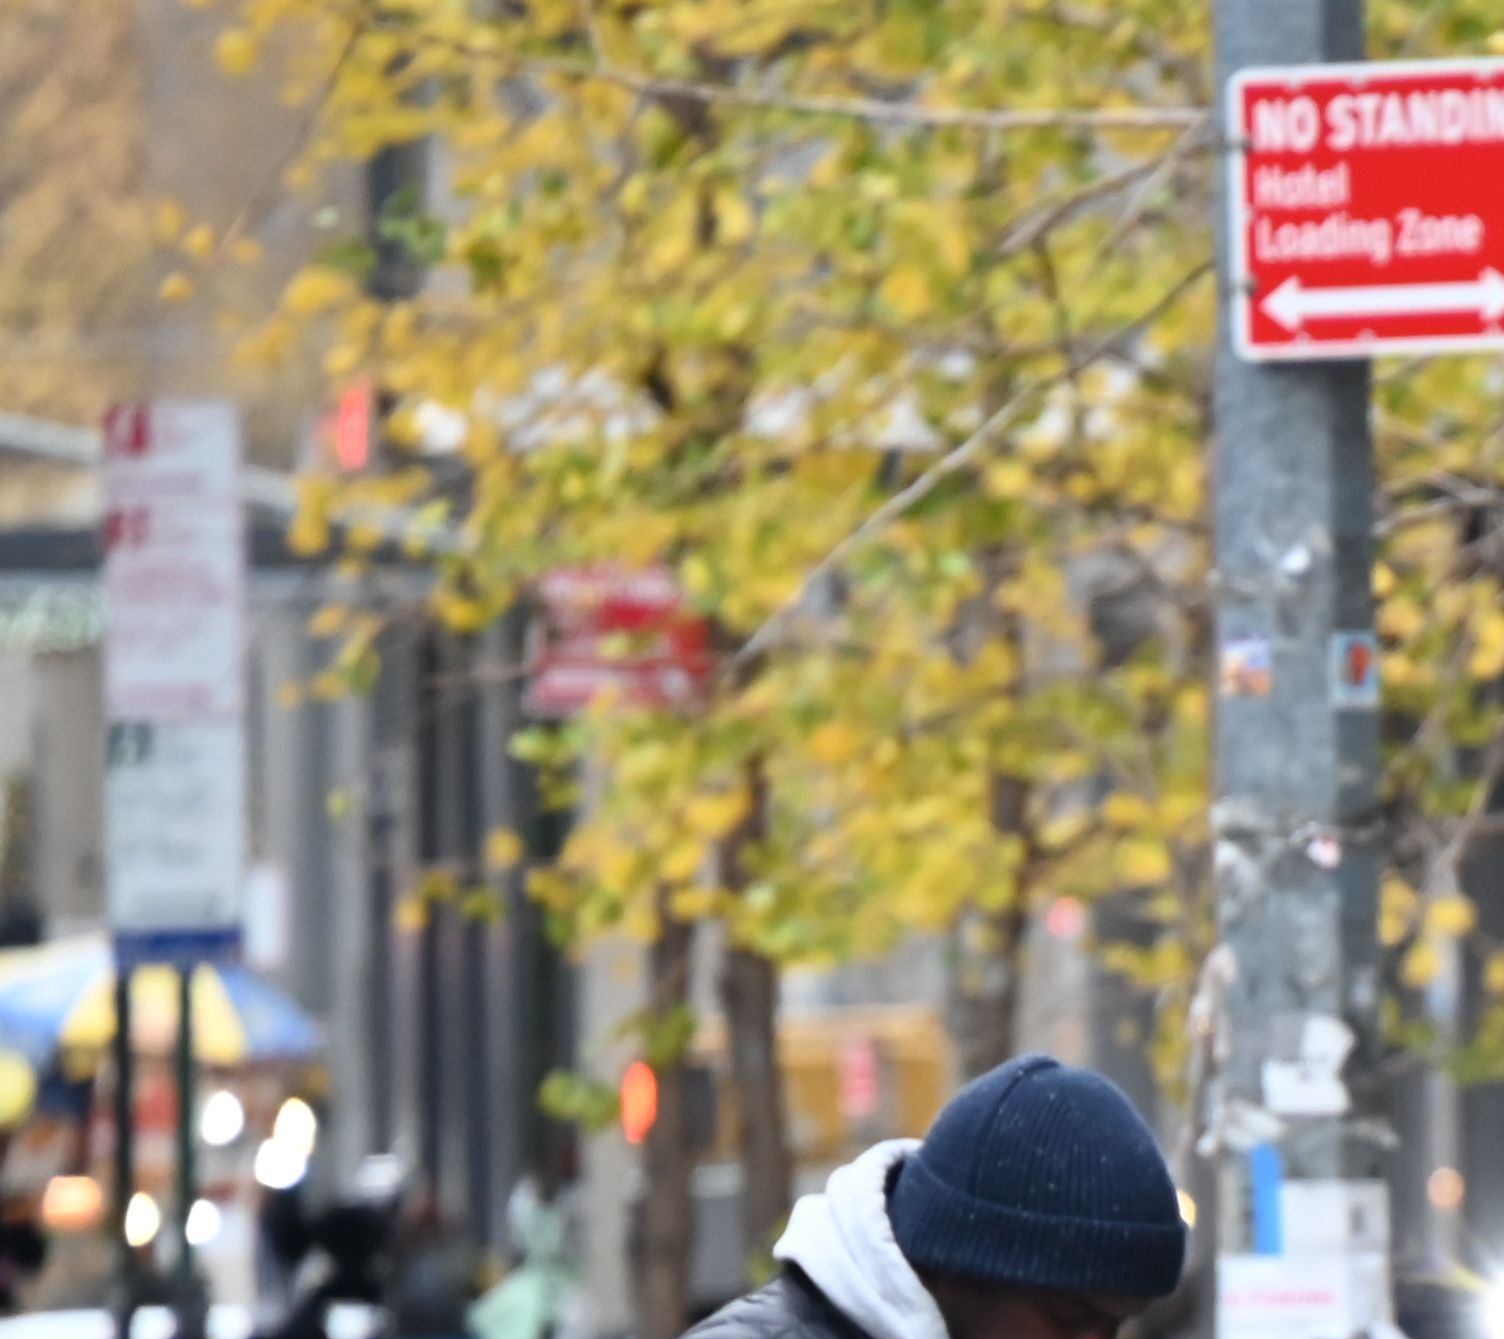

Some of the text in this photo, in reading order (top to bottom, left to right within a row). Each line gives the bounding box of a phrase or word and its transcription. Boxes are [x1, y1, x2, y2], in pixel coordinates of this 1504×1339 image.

[1253, 95, 1321, 153] NO
[1253, 160, 1348, 209] Hotel
[1255, 207, 1483, 266] Loading Zone
